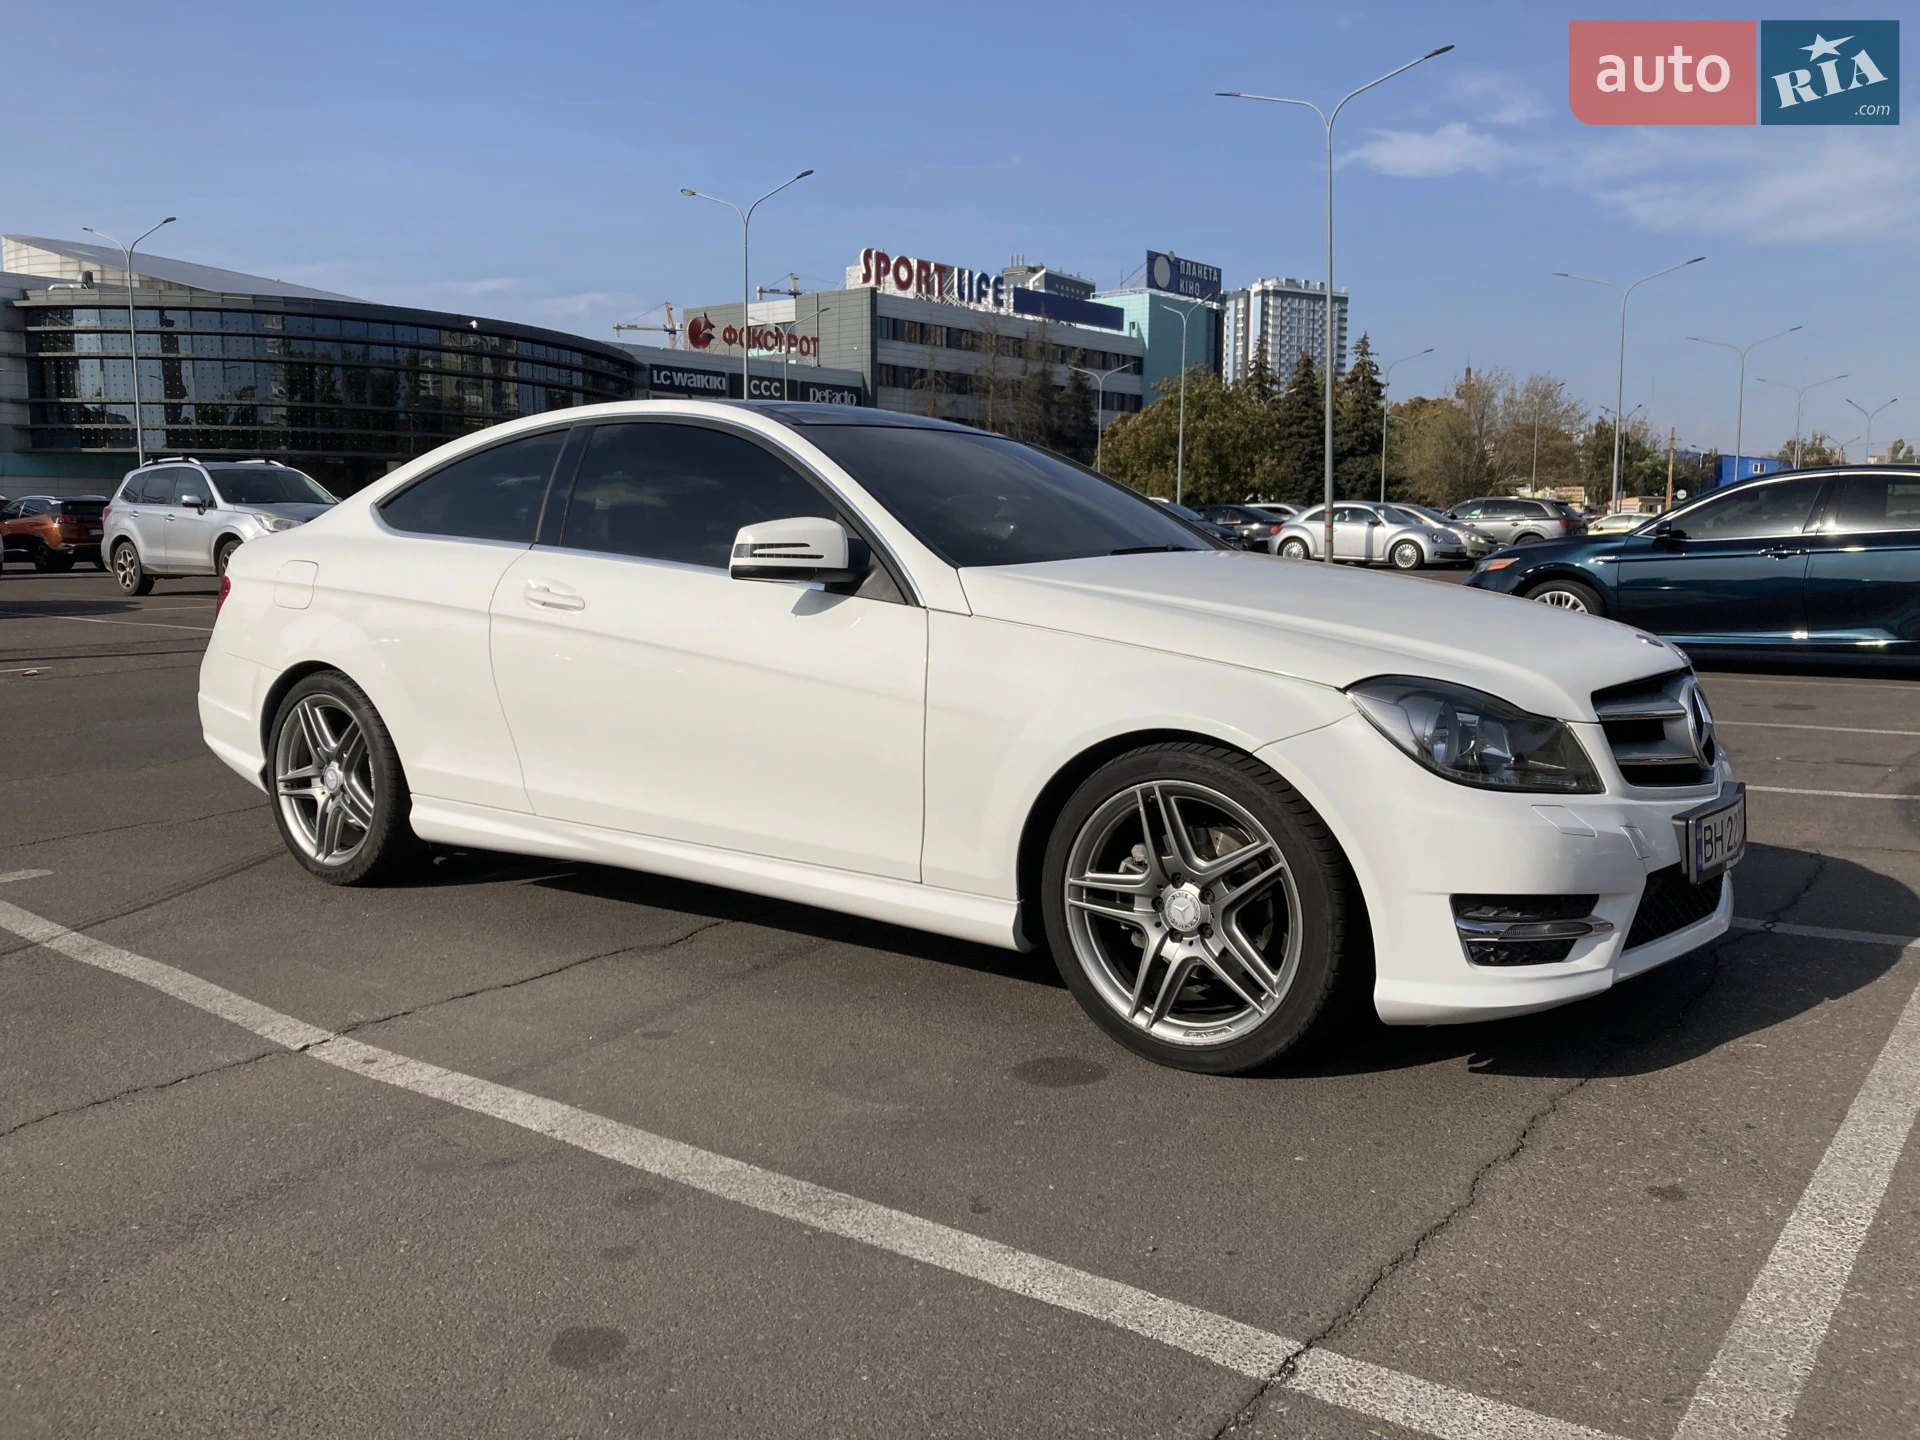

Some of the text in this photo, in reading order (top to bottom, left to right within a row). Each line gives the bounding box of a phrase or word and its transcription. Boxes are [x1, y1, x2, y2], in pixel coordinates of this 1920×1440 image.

[860, 247, 1006, 308] SPORT LIFE
[1180, 260, 1218, 282] ПЛАНЕТА
[1180, 279, 1200, 296] КІНО
[722, 325, 820, 358] ФОКСТРОТ
[653, 370, 671, 385] LC
[750, 379, 781, 397] CCC
[809, 387, 857, 407] DeFacto
[1703, 819, 1723, 863] BH
